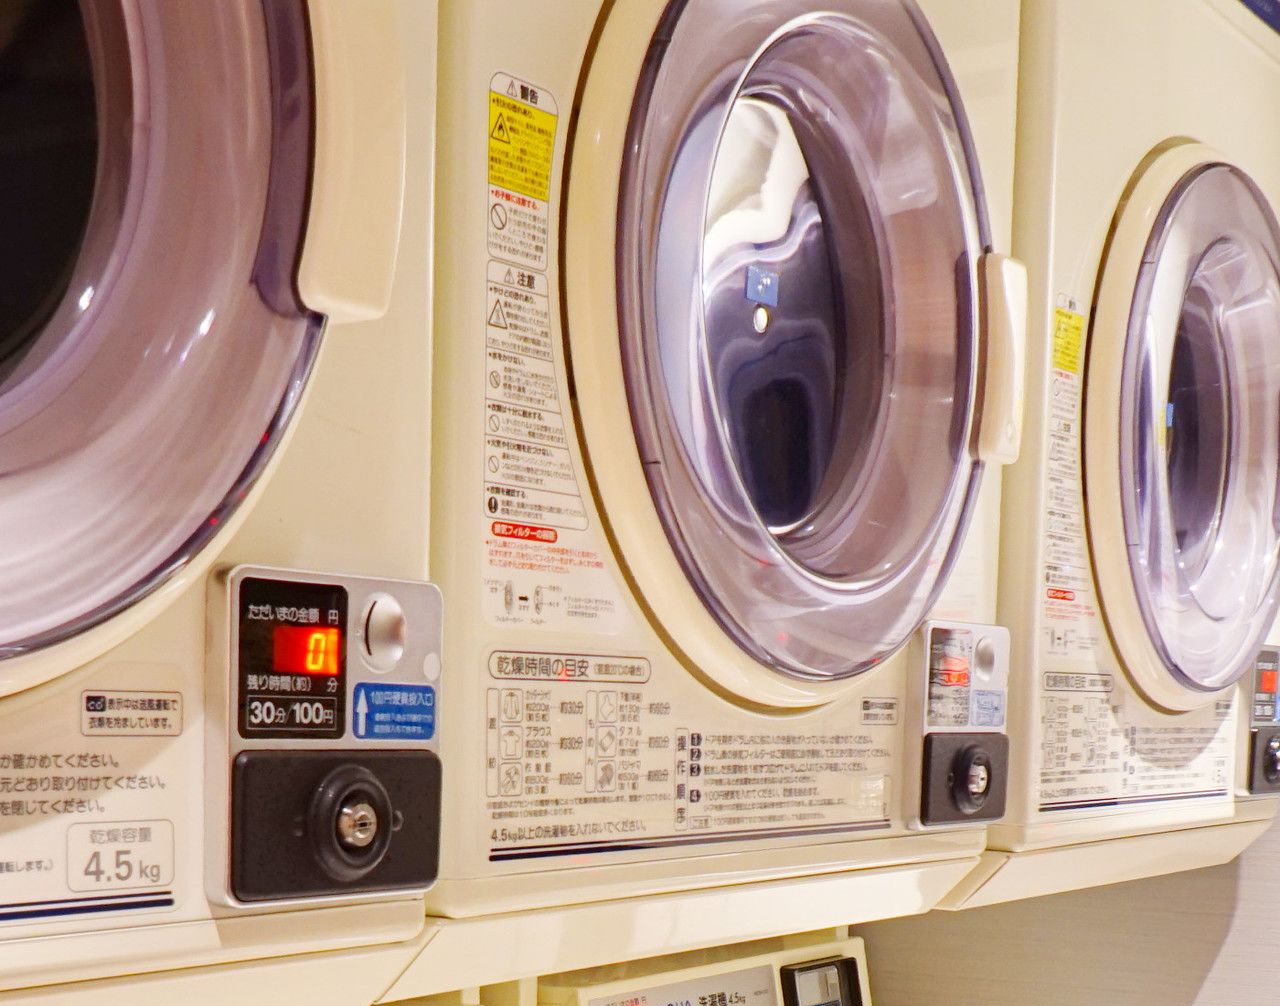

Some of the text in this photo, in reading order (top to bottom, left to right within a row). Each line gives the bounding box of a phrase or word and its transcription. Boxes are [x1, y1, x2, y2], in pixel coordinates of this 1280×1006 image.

[517, 272, 536, 291] 注意
[327, 609, 339, 625] 円
[305, 632, 326, 670] 0
[496, 654, 590, 679] 乾燥時間の目安
[326, 679, 339, 693] 分
[88, 826, 152, 845] 乾燥容量
[83, 849, 161, 883] 4.5kg
